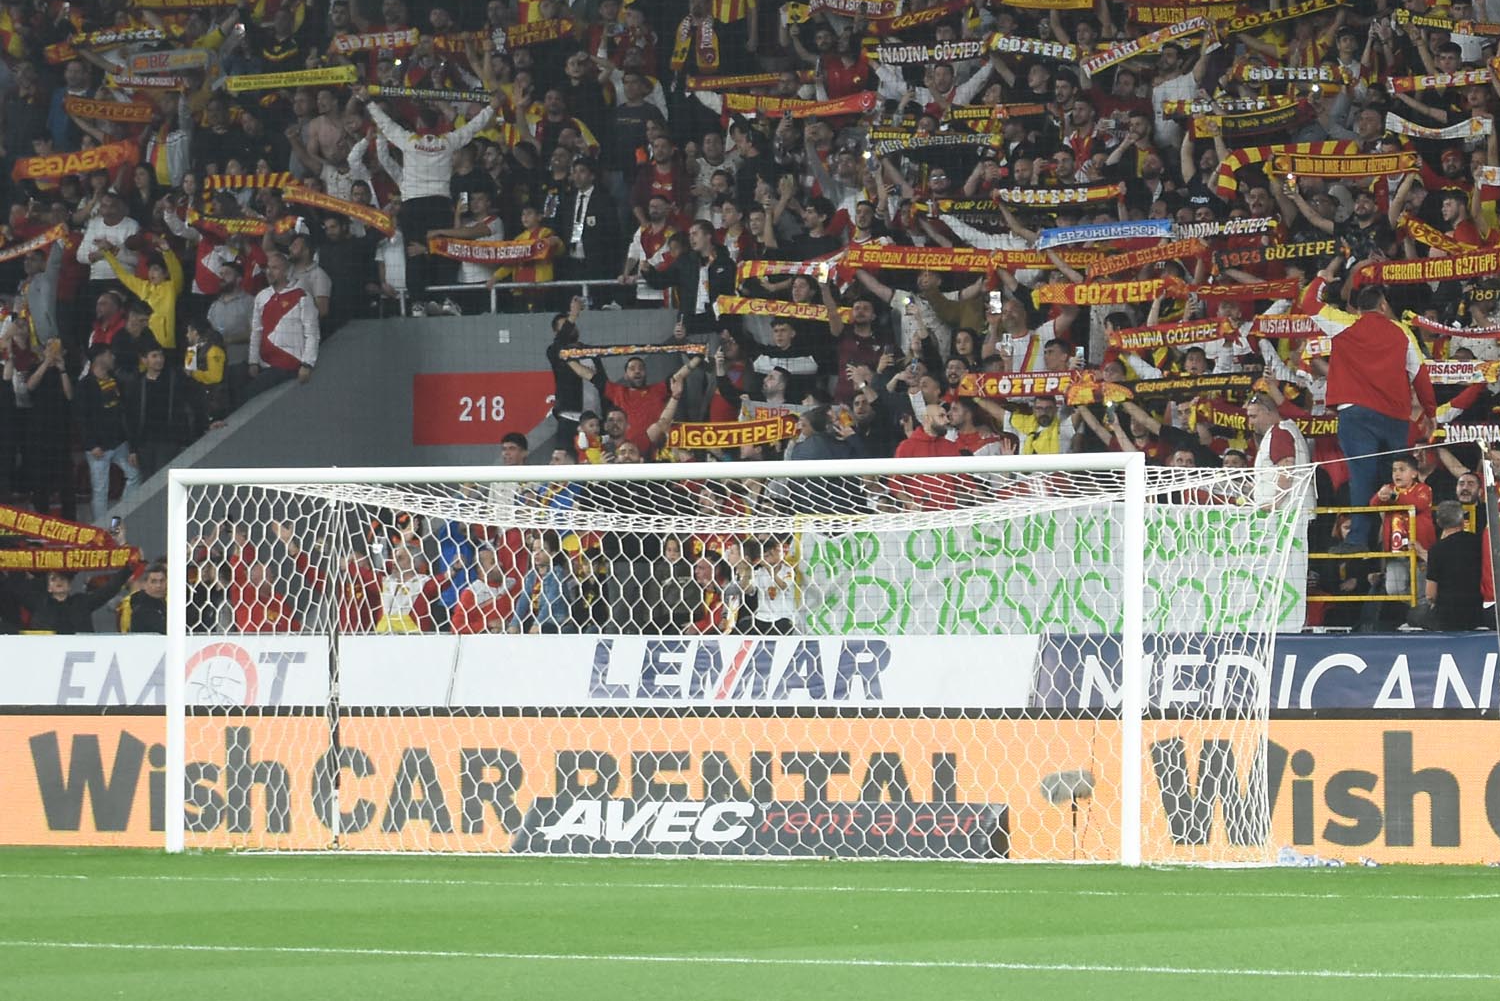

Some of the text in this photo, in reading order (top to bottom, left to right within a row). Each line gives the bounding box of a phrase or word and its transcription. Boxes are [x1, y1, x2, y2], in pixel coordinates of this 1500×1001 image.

[459, 395, 505, 422] 218
[687, 422, 778, 446] GÖZTEPE
[1311, 419, 1338, 434] İZMİ
[1444, 422, 1500, 444] İNADINA
[29, 727, 290, 834] Wish
[312, 746, 524, 835] CAR
[1150, 730, 1460, 848] Wish
[537, 800, 755, 842] AVEC
[760, 805, 853, 837] rent
[909, 811, 986, 836] car
